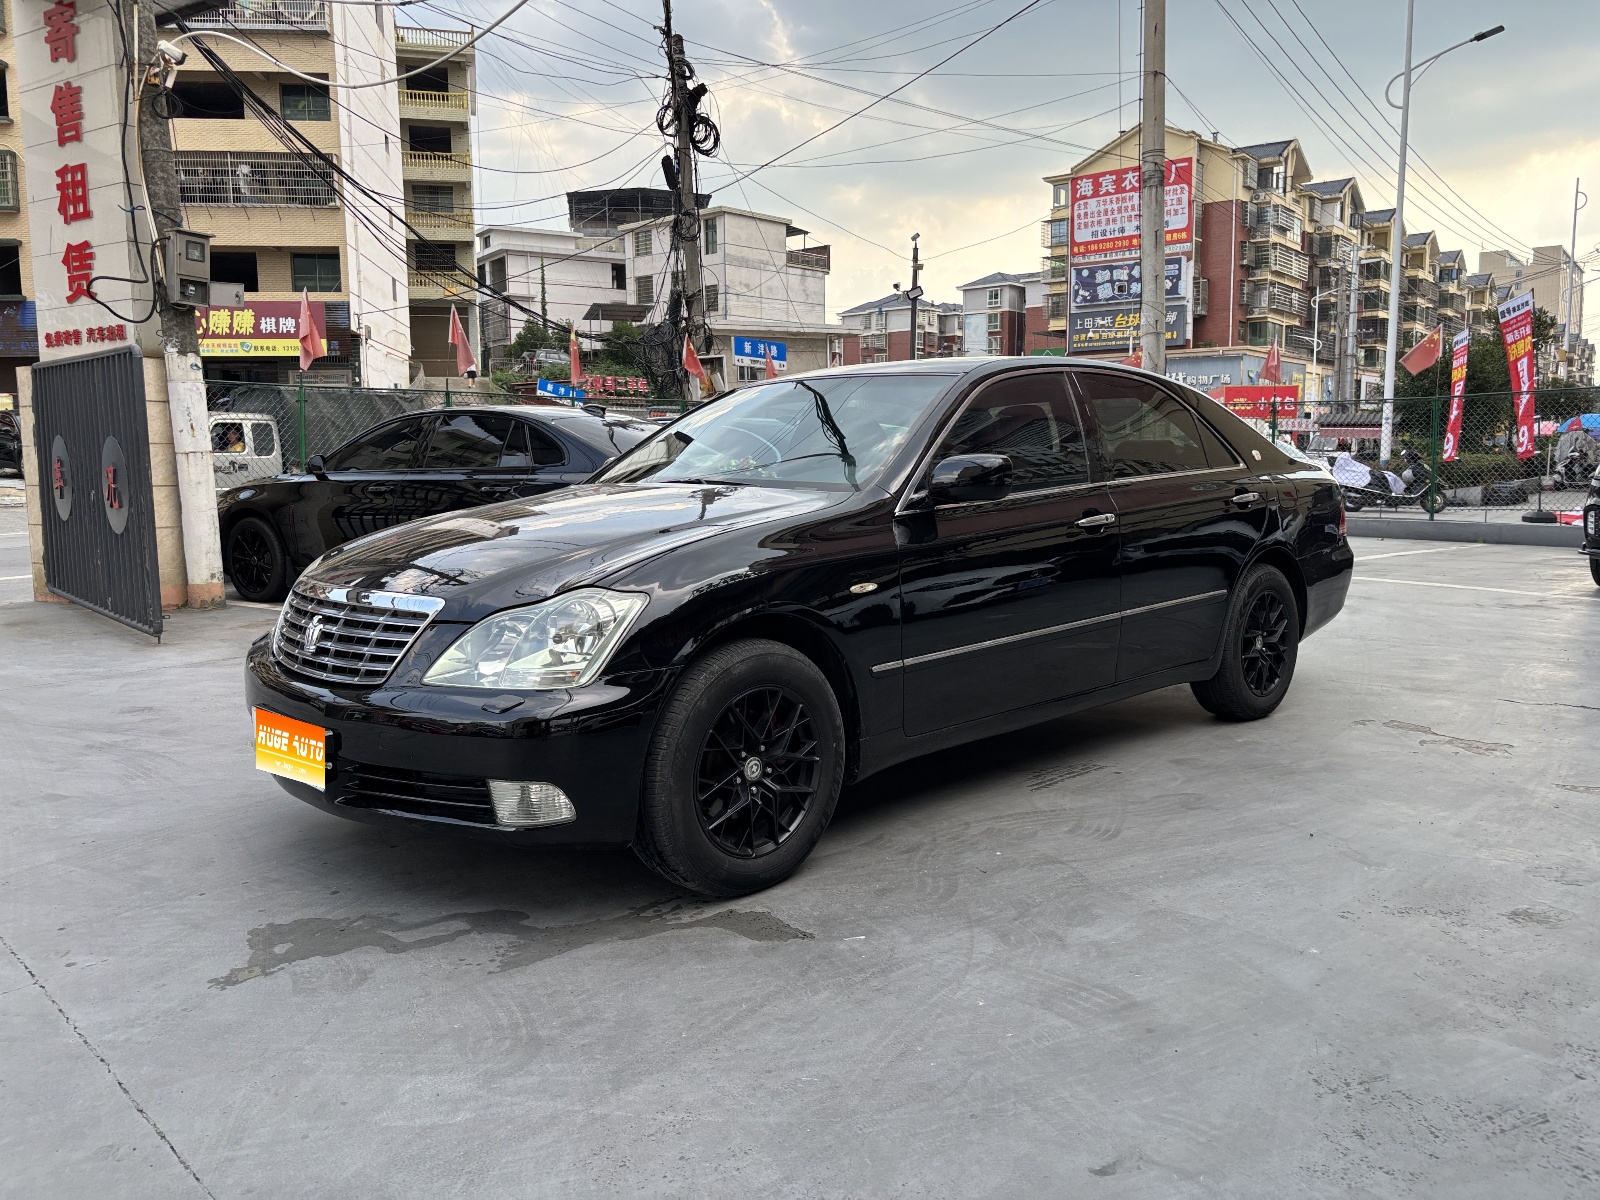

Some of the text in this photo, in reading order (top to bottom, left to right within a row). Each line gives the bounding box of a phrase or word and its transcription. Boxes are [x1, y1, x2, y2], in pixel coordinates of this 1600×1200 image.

[43, 0, 97, 304] 寄售租赁
[86, 324, 127, 343] 汽车出租
[260, 317, 301, 334] 棋牌
[744, 341, 777, 357] 新洋路
